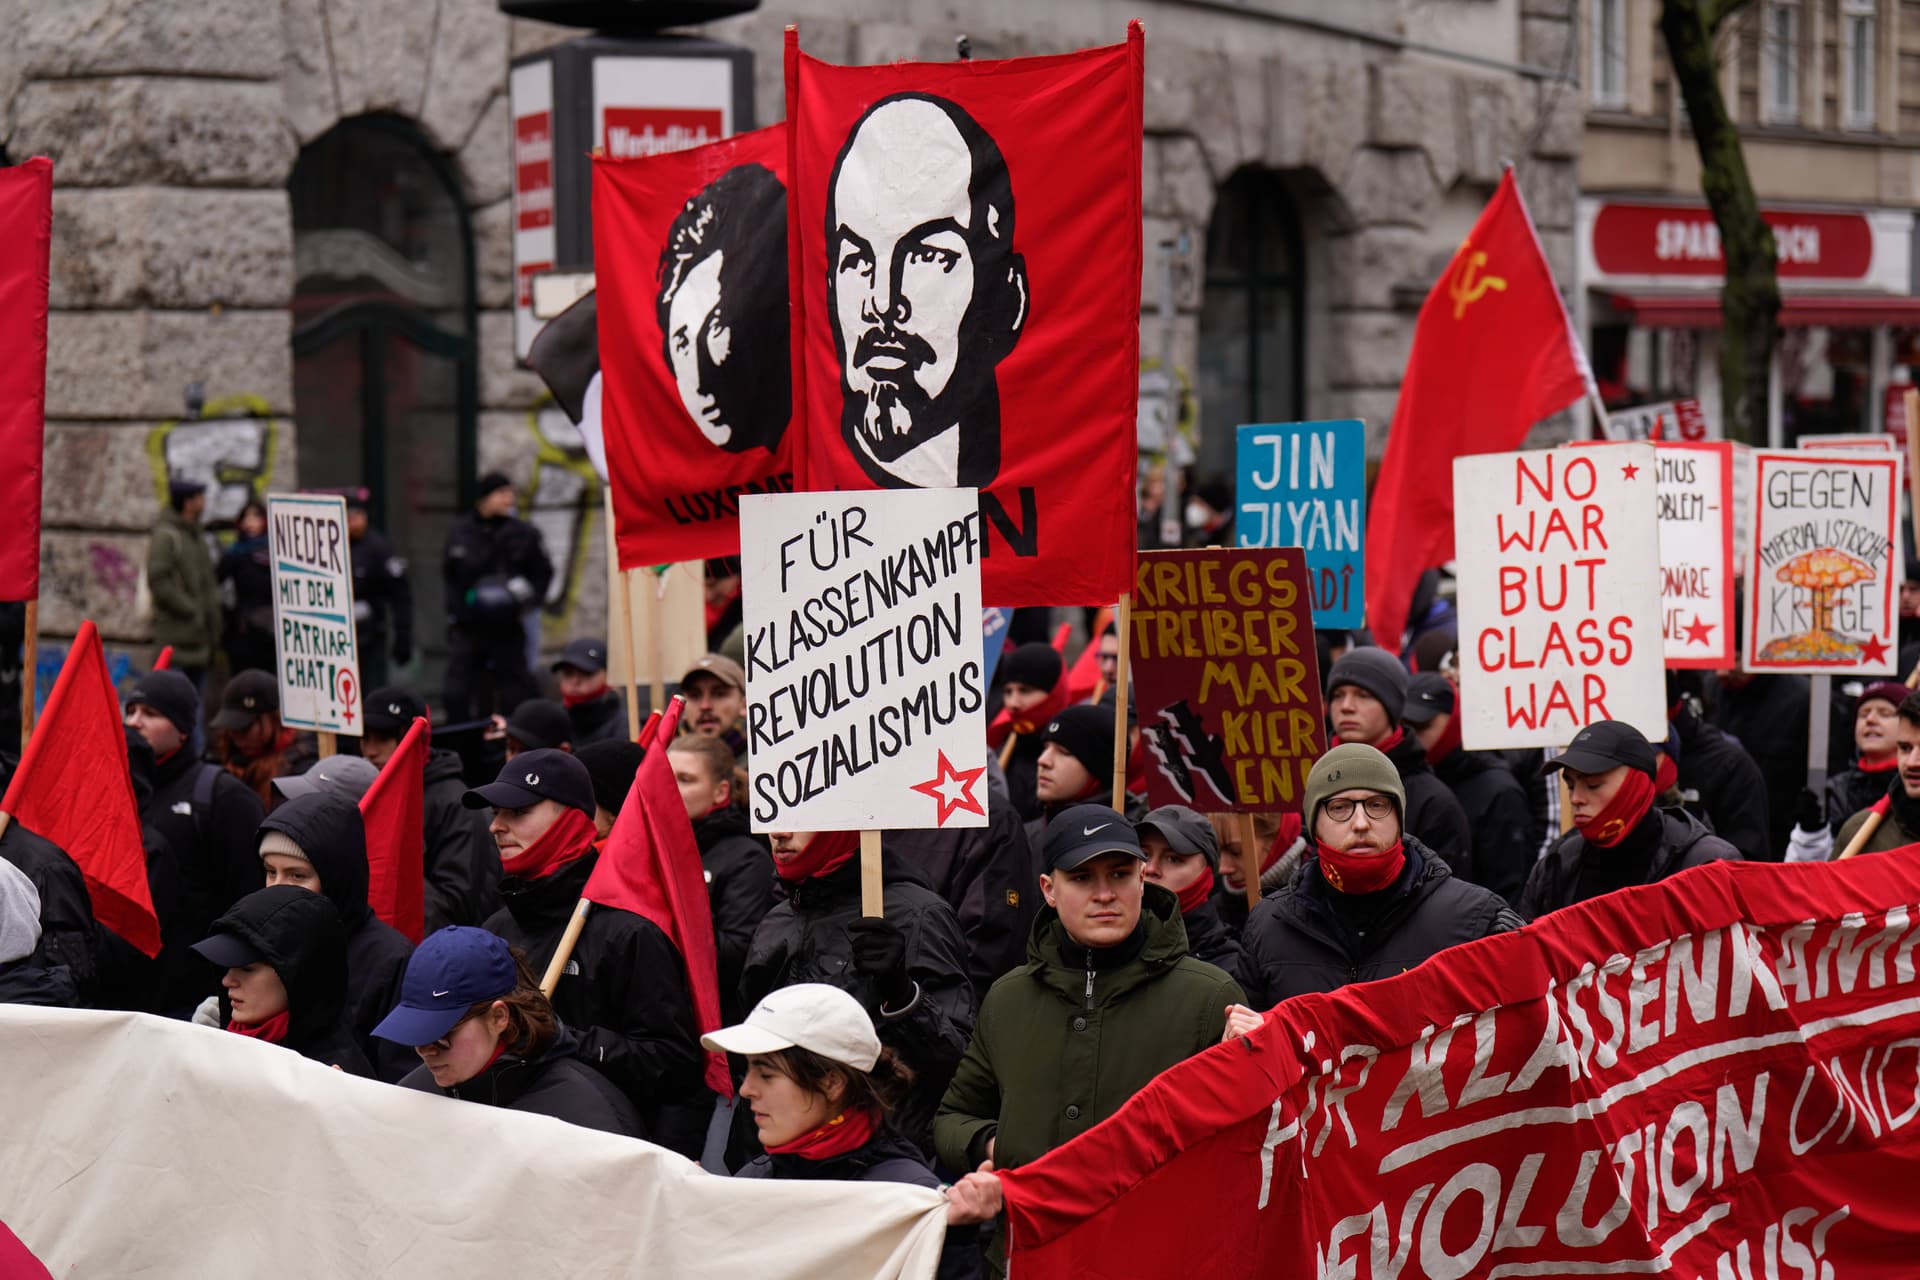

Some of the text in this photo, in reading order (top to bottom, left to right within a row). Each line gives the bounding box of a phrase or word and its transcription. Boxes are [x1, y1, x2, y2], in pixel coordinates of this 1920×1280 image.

[1252, 431, 1335, 490] JIN
[1516, 453, 1597, 505] NO
[1768, 470, 1873, 509] GEGEN
[275, 513, 342, 574] NIEDER
[781, 506, 874, 593] FÜR
[1240, 499, 1359, 552] JIYAN
[1497, 504, 1609, 553] WAR
[1759, 518, 1893, 570] IMPERIALISTISCHE
[279, 578, 334, 608] MIT DEM
[748, 511, 979, 683] KLASSENKAMPF
[1131, 559, 1298, 608] KRIEGS
[1499, 558, 1607, 616] BUT
[1770, 582, 1876, 632] KRIEGE
[1130, 610, 1300, 659] TREIBER
[1478, 615, 1633, 672] CLASS
[749, 592, 961, 755] REVOLUTION
[1198, 658, 1309, 707] MAR
[1505, 673, 1613, 730] WAR
[754, 661, 982, 823] SOZIALISMUS
[1221, 708, 1318, 757] KIER
[1317, 1072, 1770, 1280] EVOLUTION
